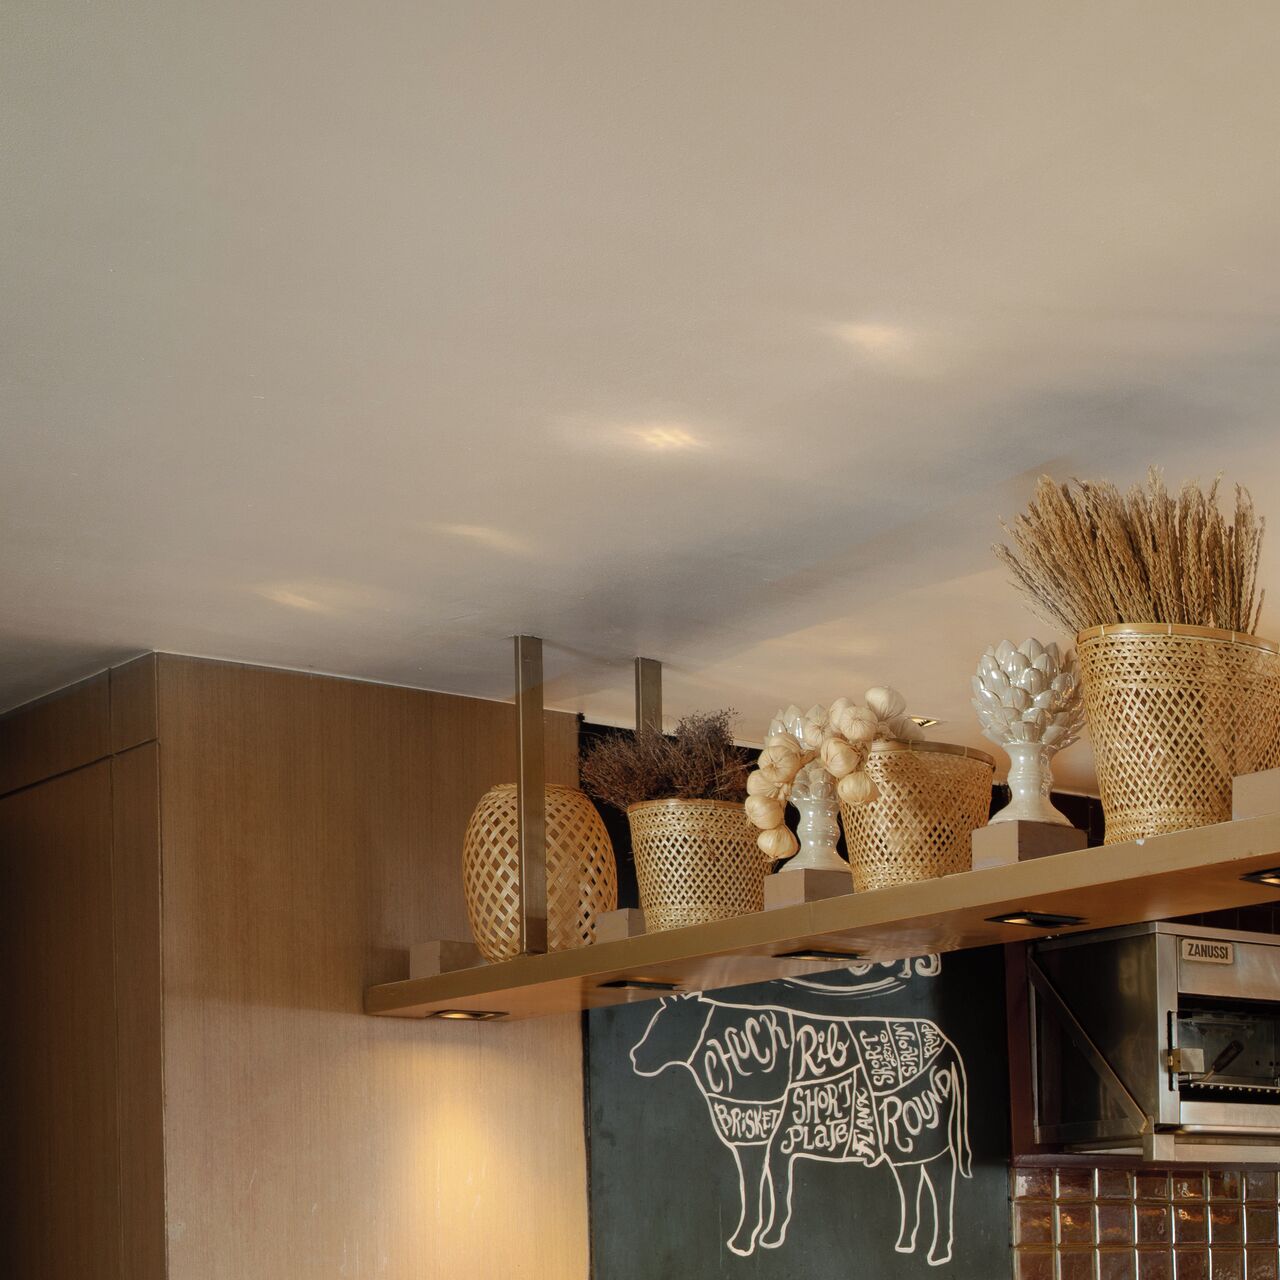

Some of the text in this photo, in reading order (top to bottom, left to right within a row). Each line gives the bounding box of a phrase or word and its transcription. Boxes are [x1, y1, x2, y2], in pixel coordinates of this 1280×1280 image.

[1187, 943, 1229, 960] ZANUSSI
[704, 1010, 790, 1093] CHUCK
[796, 1023, 850, 1080] Rib
[921, 1023, 941, 1058] RUMP
[792, 1076, 853, 1124] SHORT
[879, 1065, 951, 1153] ROUND
